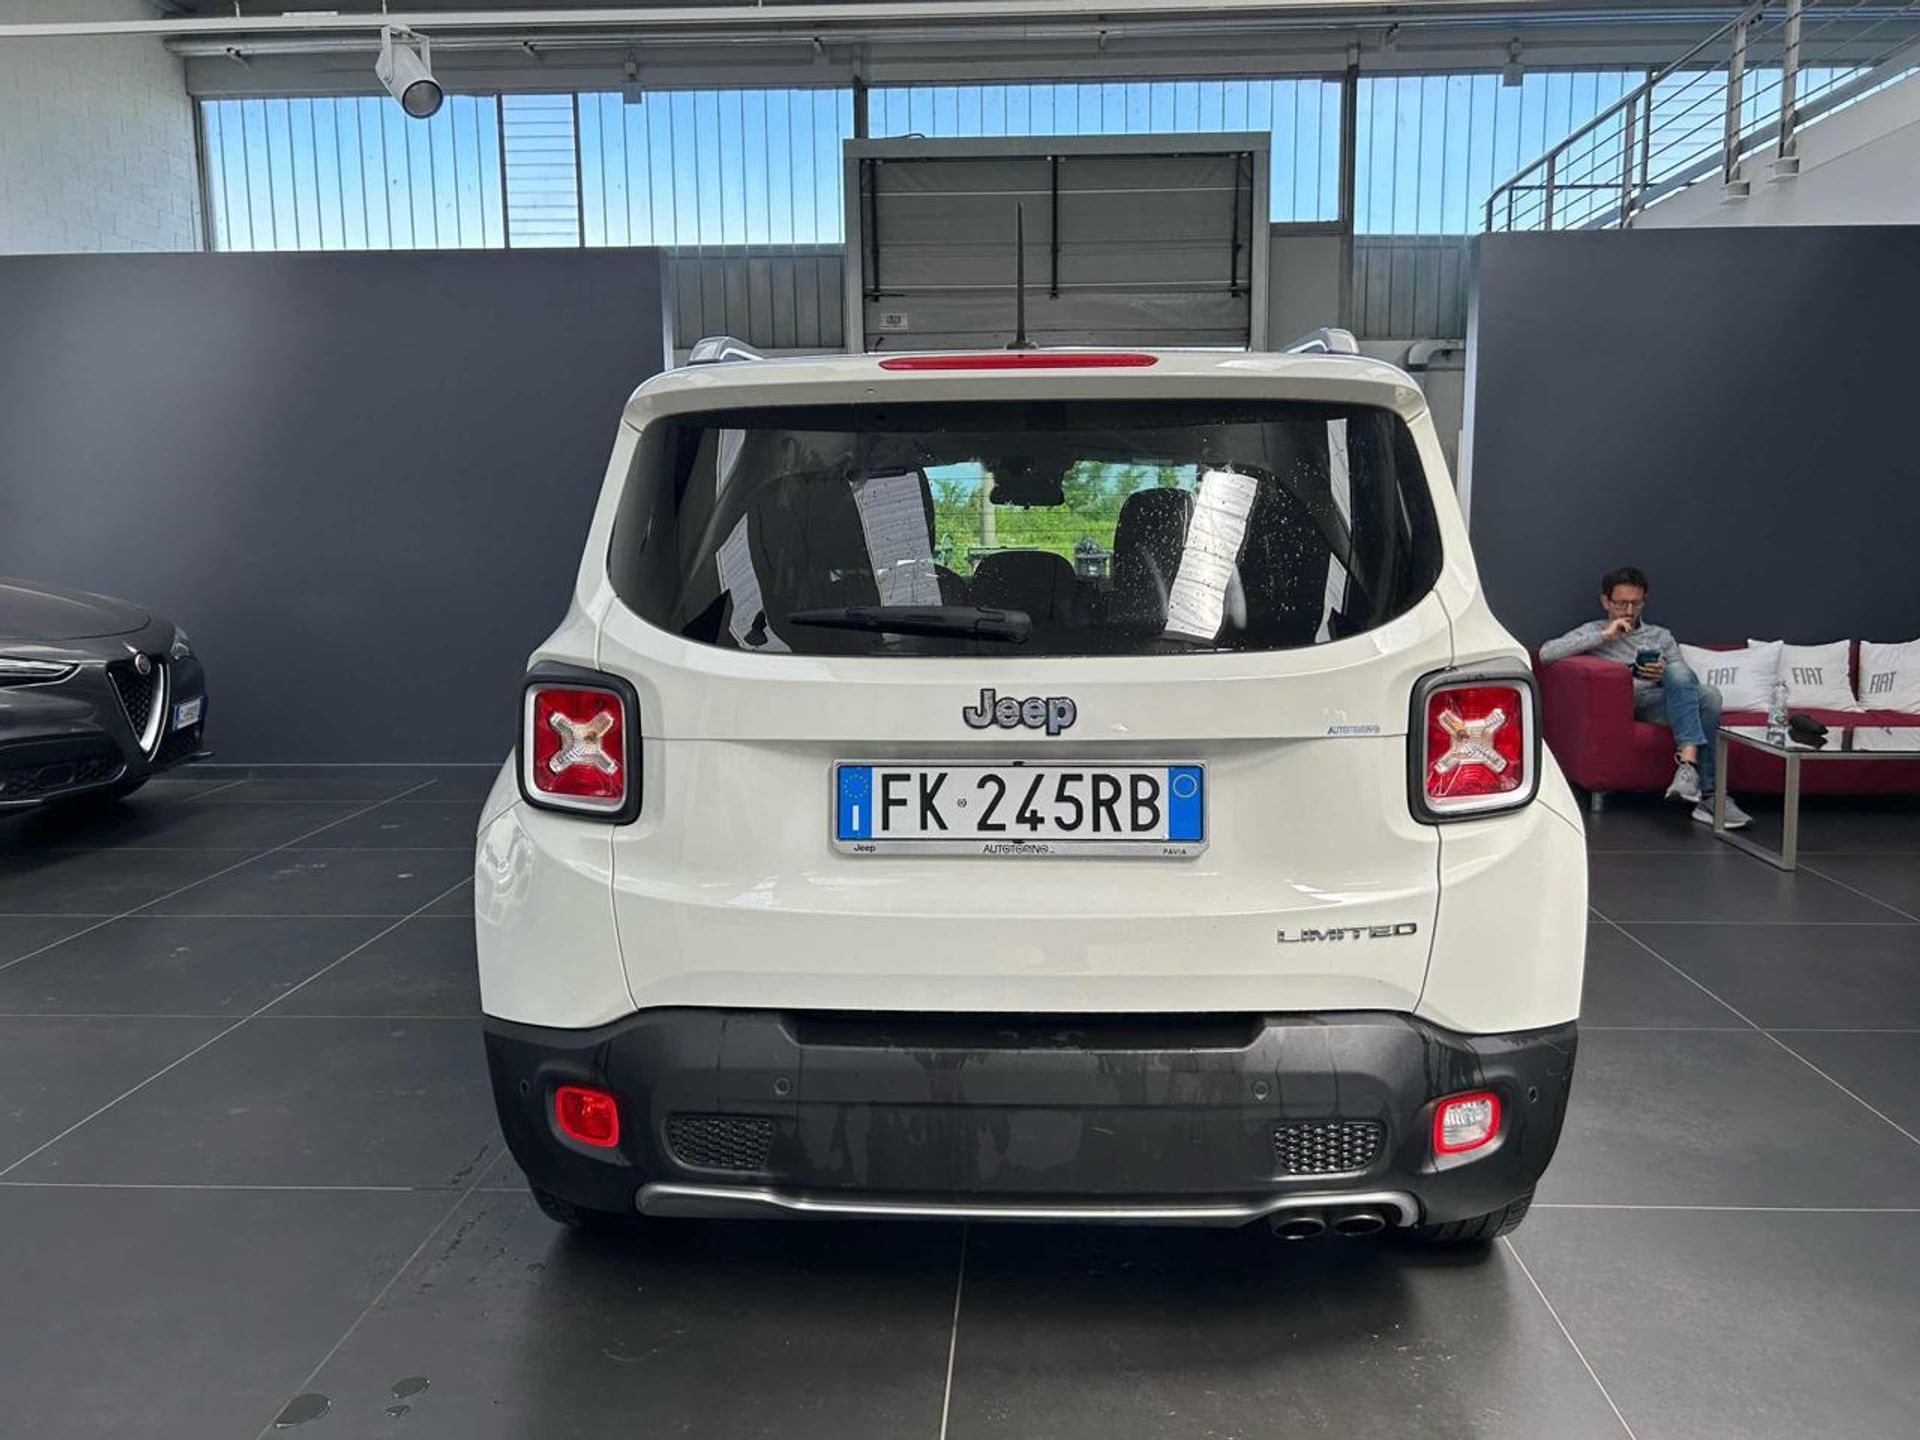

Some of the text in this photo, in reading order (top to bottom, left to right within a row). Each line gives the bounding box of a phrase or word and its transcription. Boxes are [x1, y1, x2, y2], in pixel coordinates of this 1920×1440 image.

[1707, 667, 1739, 686] FIAT
[1792, 667, 1824, 686] FIAT
[1869, 671, 1897, 694] FIAT
[963, 688, 1077, 736] Jeep
[976, 773, 1161, 832] 245RB
[853, 844, 876, 853] Jeep
[1277, 922, 1417, 942] LIMITED
